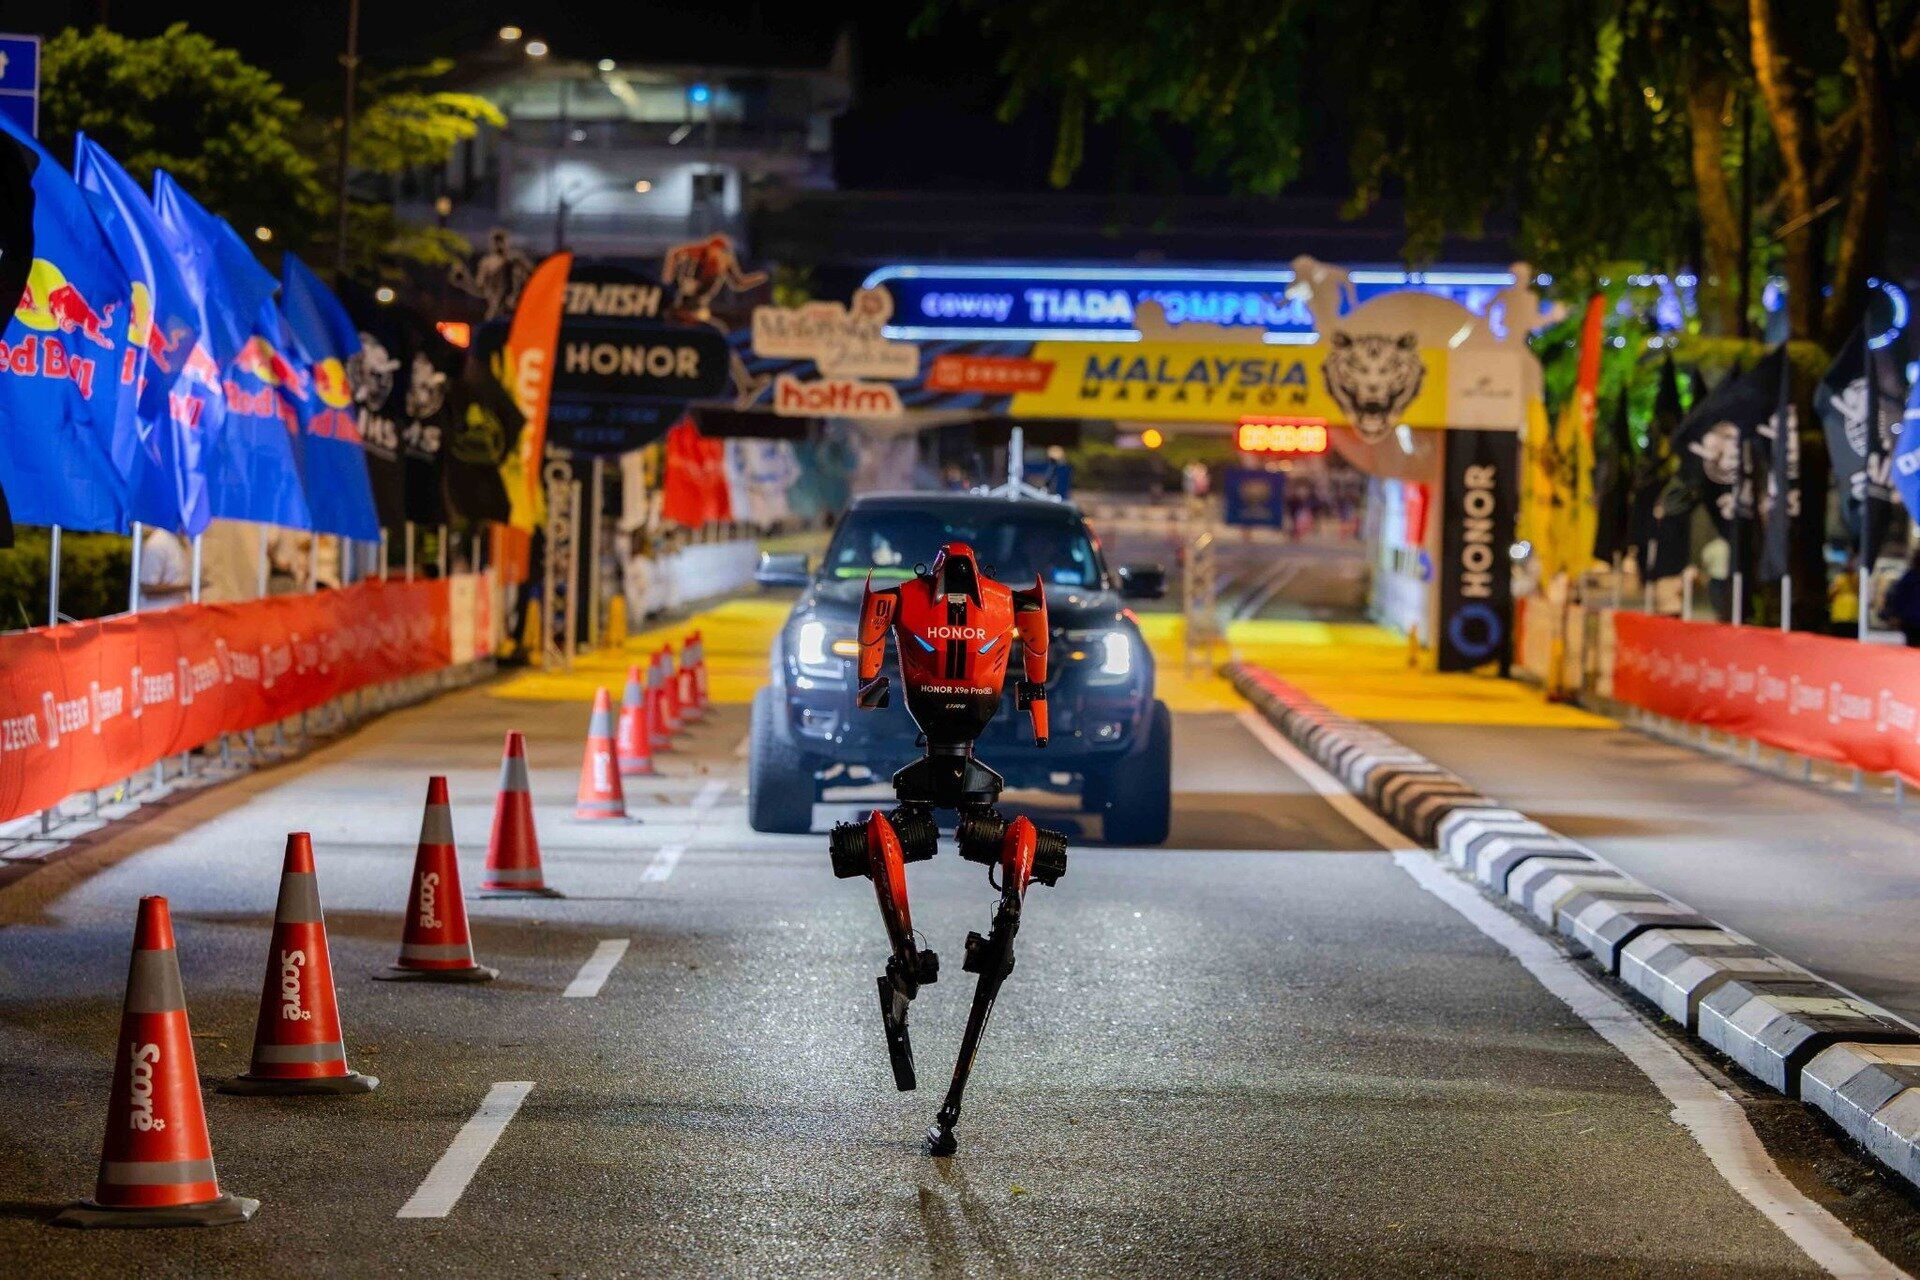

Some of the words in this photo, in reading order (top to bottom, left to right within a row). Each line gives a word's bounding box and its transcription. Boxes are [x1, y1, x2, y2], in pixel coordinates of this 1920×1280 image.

[564, 342, 699, 379] HONOR
[1084, 355, 1309, 387] MALAYSIA
[1460, 463, 1496, 599] HONOR
[927, 626, 987, 640] HONOR
[920, 684, 953, 695] HONOR
[2, 713, 41, 751] ZEEKR
[420, 871, 440, 929] Score
[281, 949, 306, 1022] Score
[130, 1042, 160, 1132] Score
